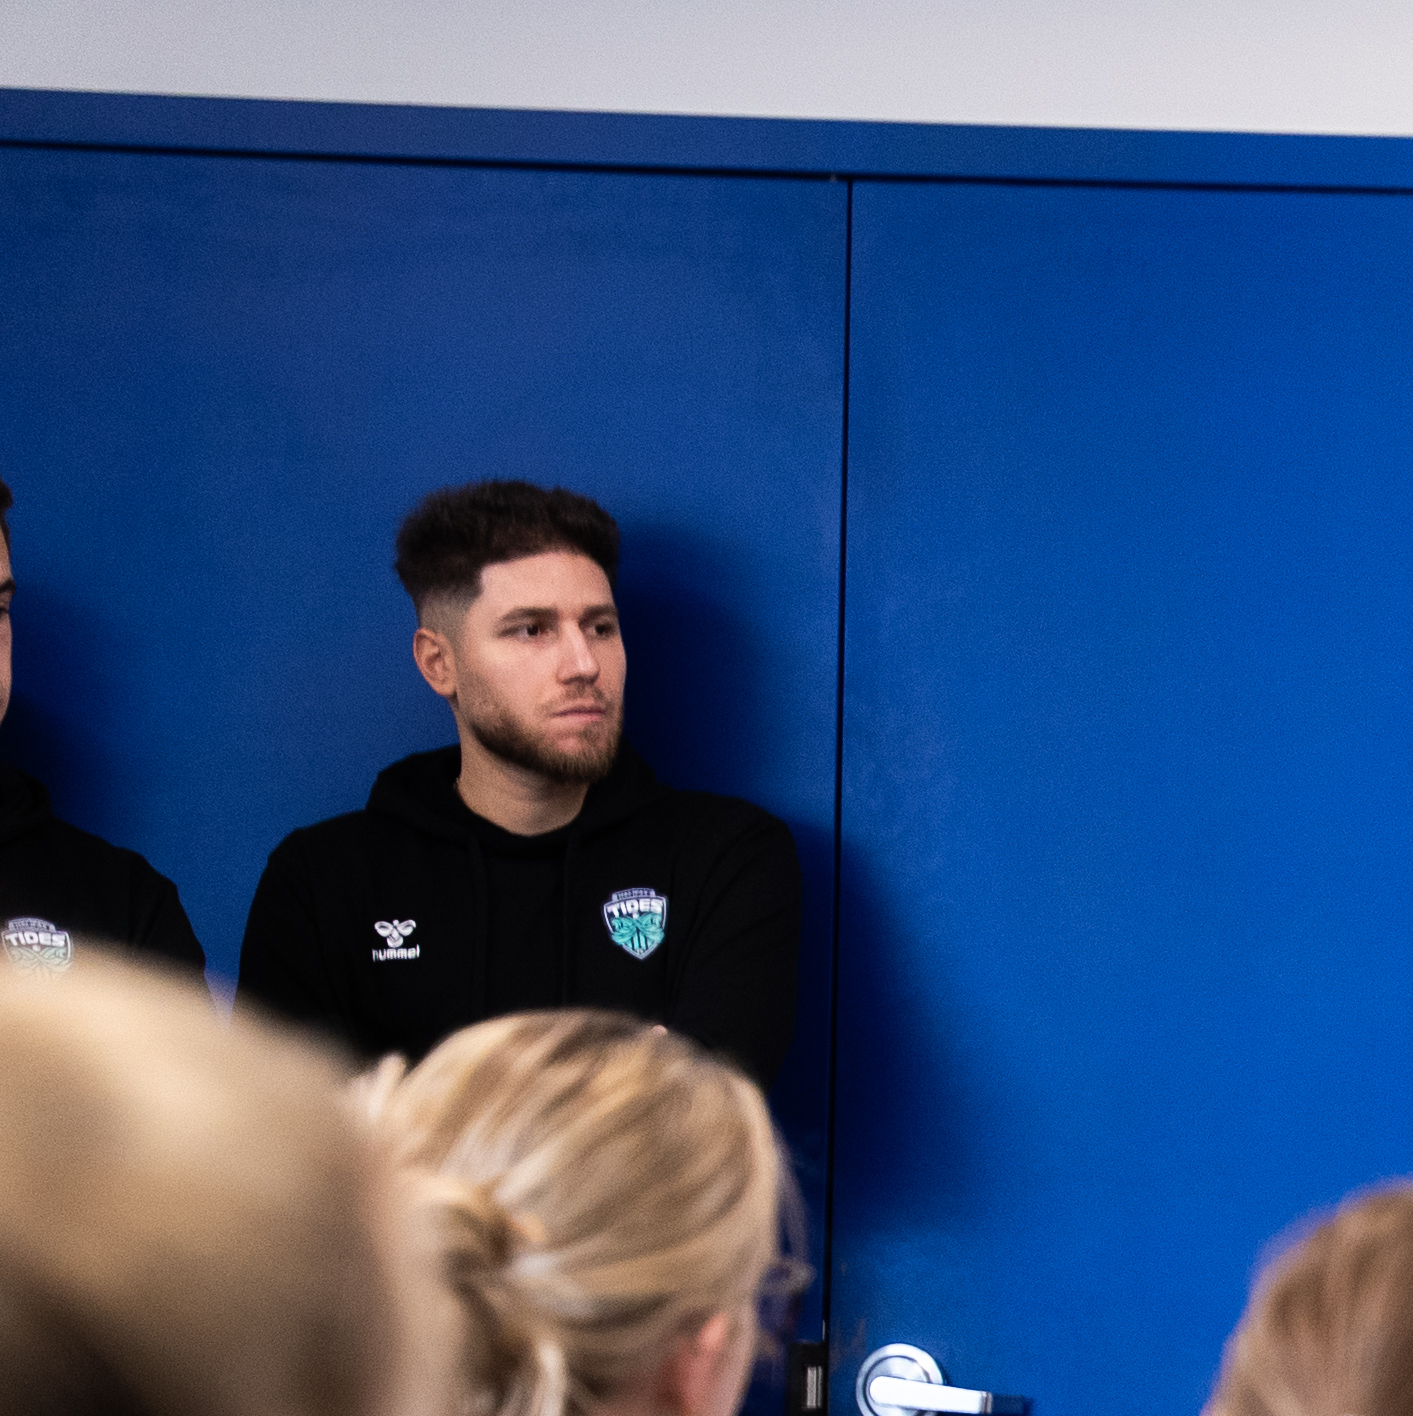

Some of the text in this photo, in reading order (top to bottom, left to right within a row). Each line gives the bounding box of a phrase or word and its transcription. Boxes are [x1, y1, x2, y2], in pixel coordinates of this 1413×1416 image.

[607, 898, 663, 918] TIDES
[5, 932, 65, 948] TIDES
[372, 944, 420, 962] hummel
